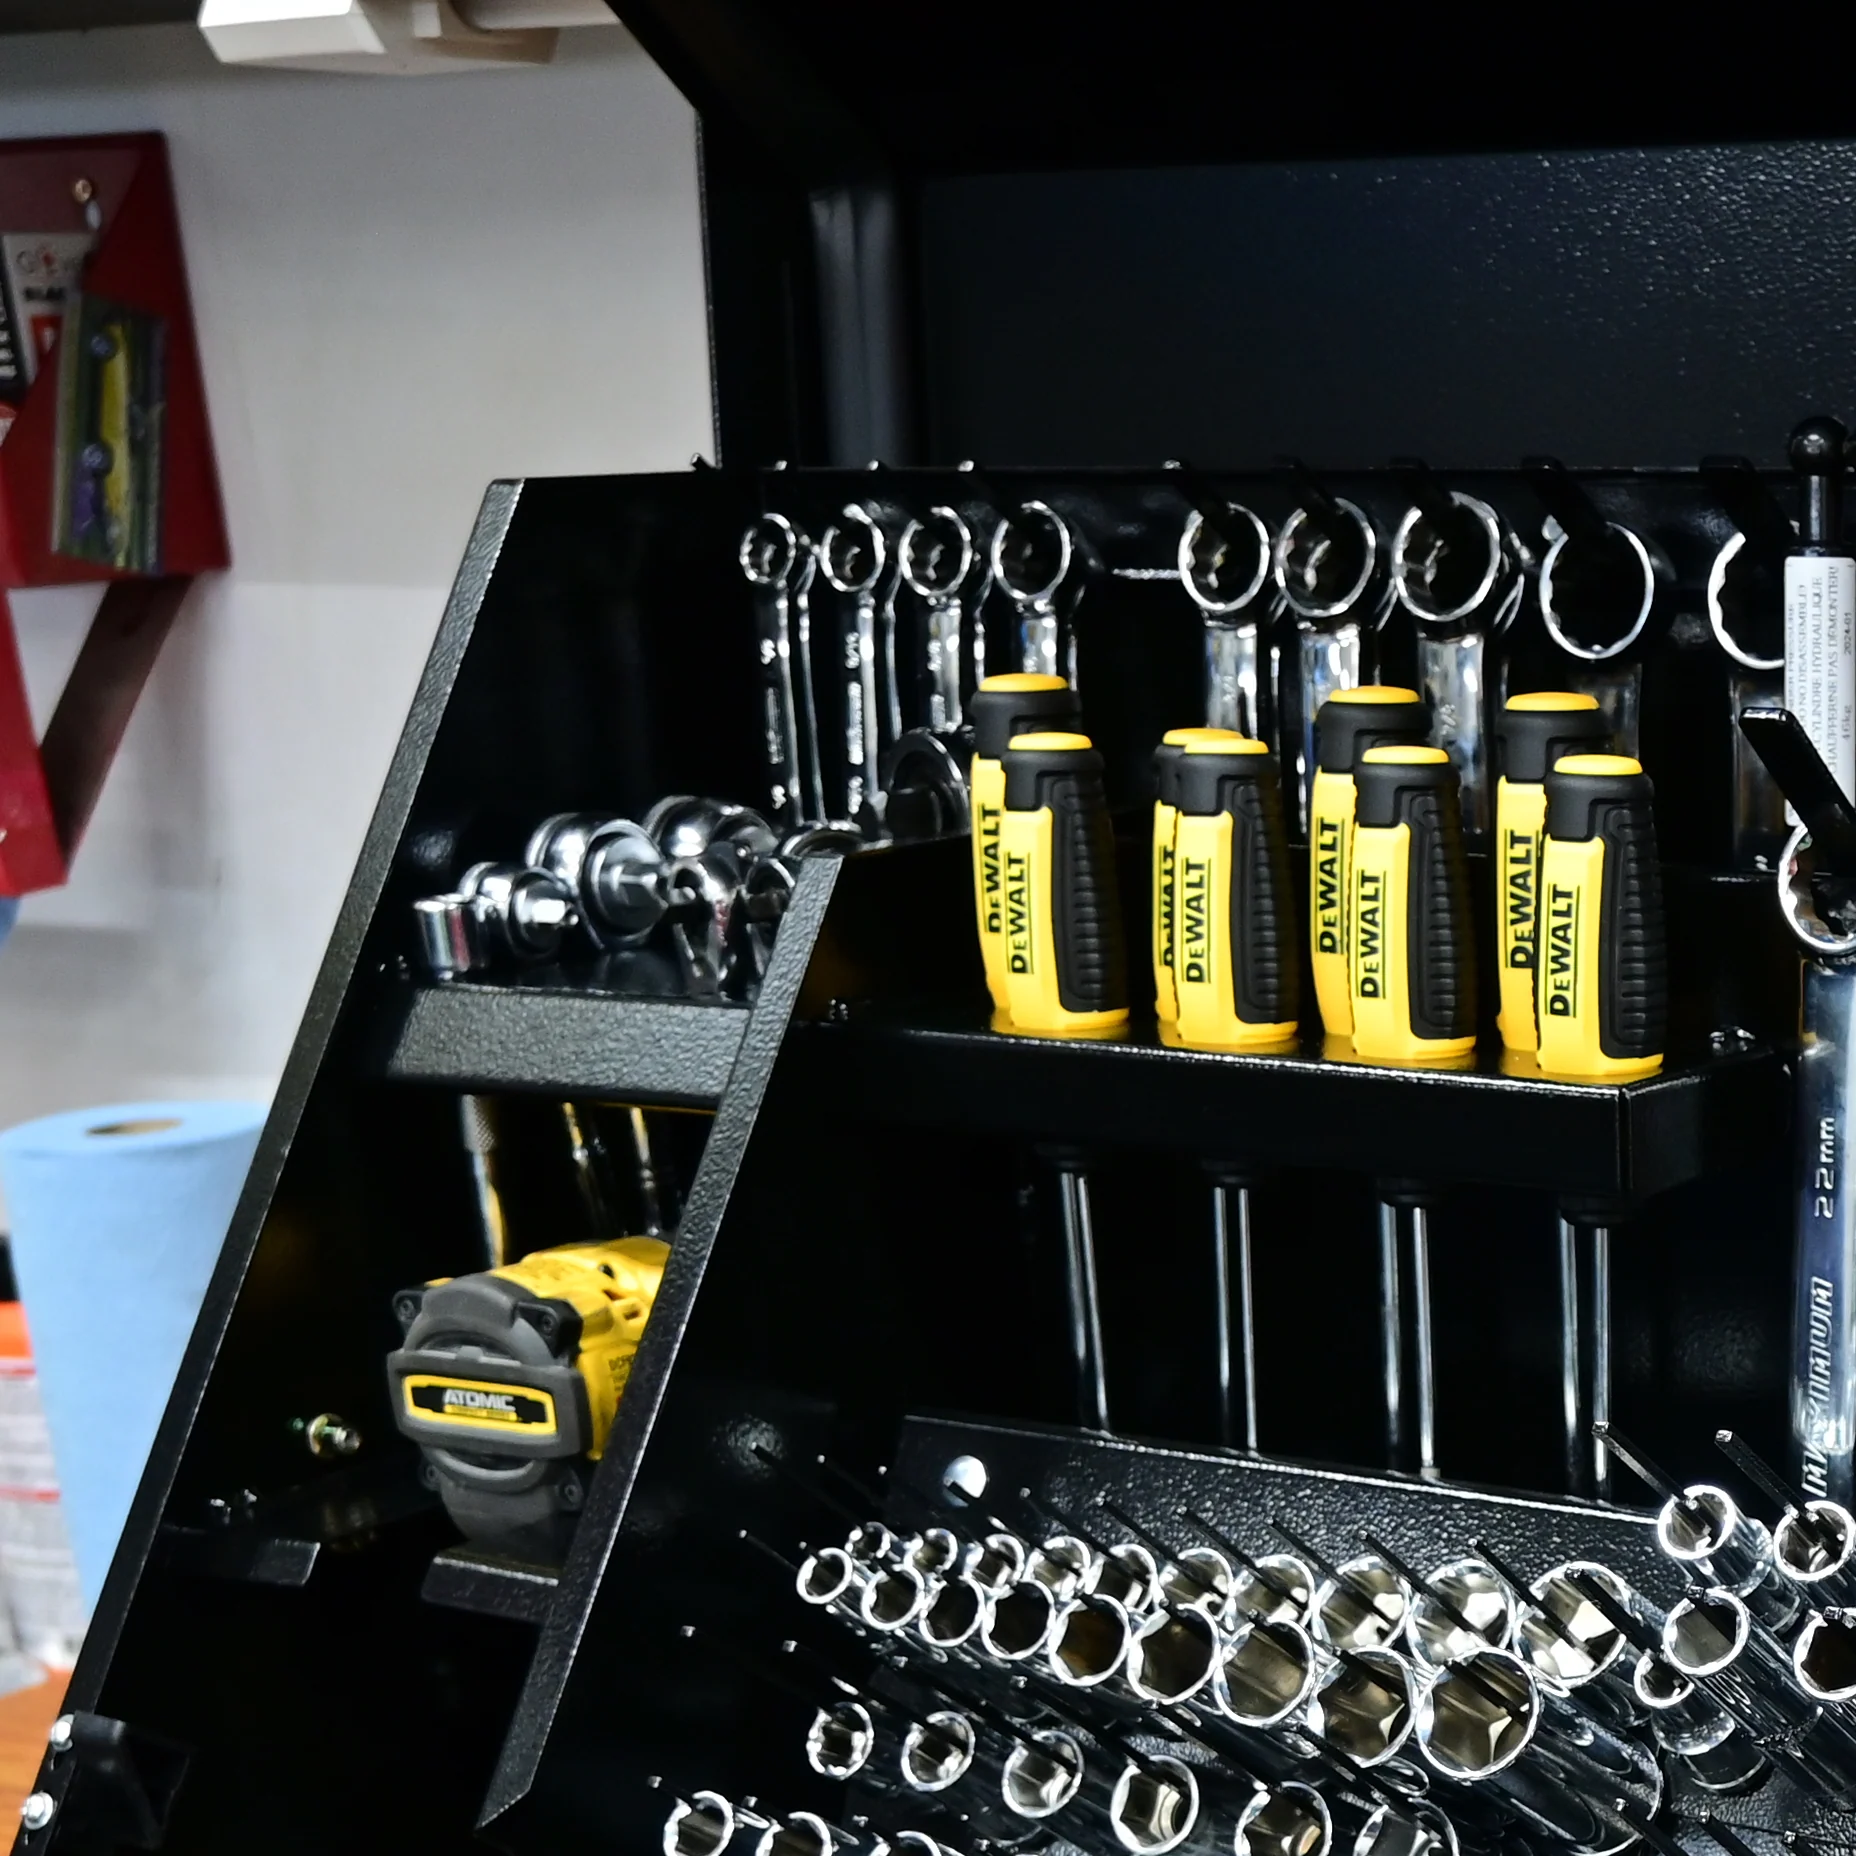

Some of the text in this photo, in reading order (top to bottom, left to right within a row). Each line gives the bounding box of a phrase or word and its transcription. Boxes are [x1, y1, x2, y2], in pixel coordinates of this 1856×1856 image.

[1843, 612, 1853, 656] 2024-01
[1007, 852, 1029, 974] DEWALT
[1184, 857, 1207, 984] DEWALT
[1318, 816, 1340, 954] DEWALT
[1360, 869, 1381, 999] DEWALT
[1509, 829, 1534, 970] DEWALT
[1549, 883, 1574, 1017] DEWALT
[442, 1388, 516, 1411] ATOMIC
